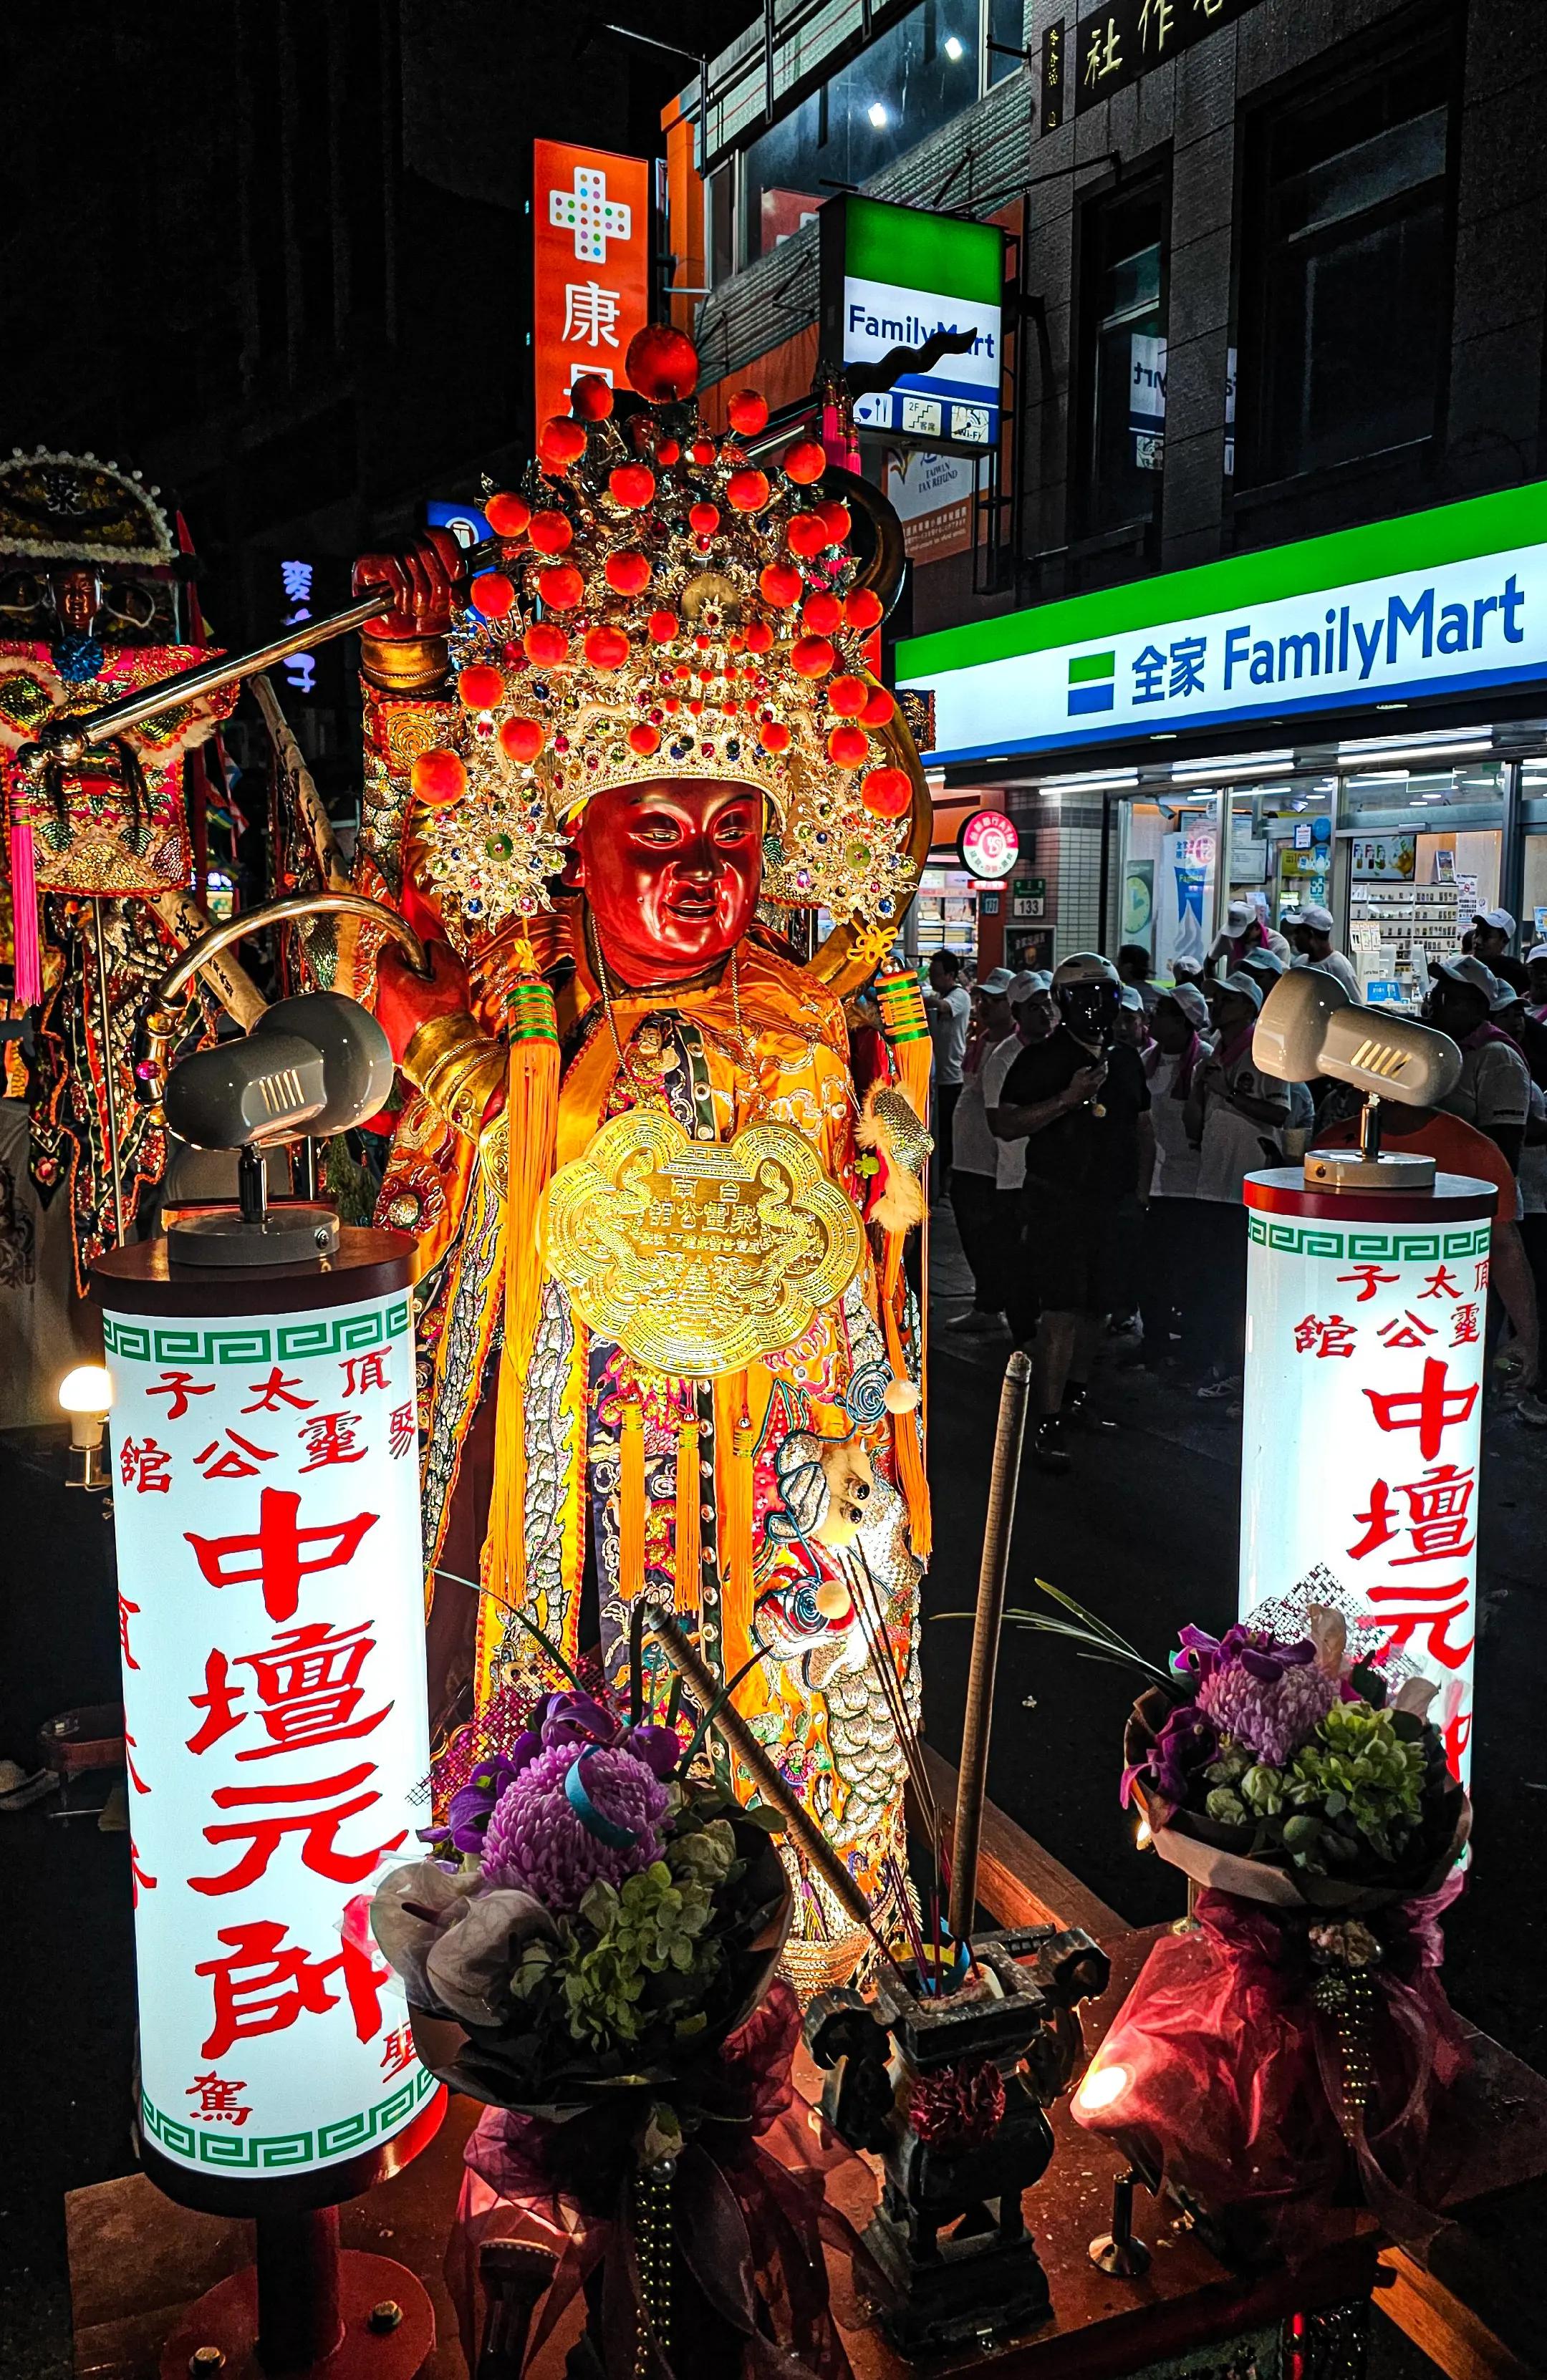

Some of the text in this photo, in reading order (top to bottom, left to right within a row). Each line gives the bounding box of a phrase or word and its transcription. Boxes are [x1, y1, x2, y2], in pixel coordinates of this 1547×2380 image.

[849, 304, 995, 359] Familyrt
[908, 401, 920, 412] 2F
[918, 469, 958, 493] TAX REFUND
[1132, 574, 1525, 705] 全家 FamilyMart
[1019, 899, 1038, 914] 133
[183, 1486, 408, 2060] 中壇元帥
